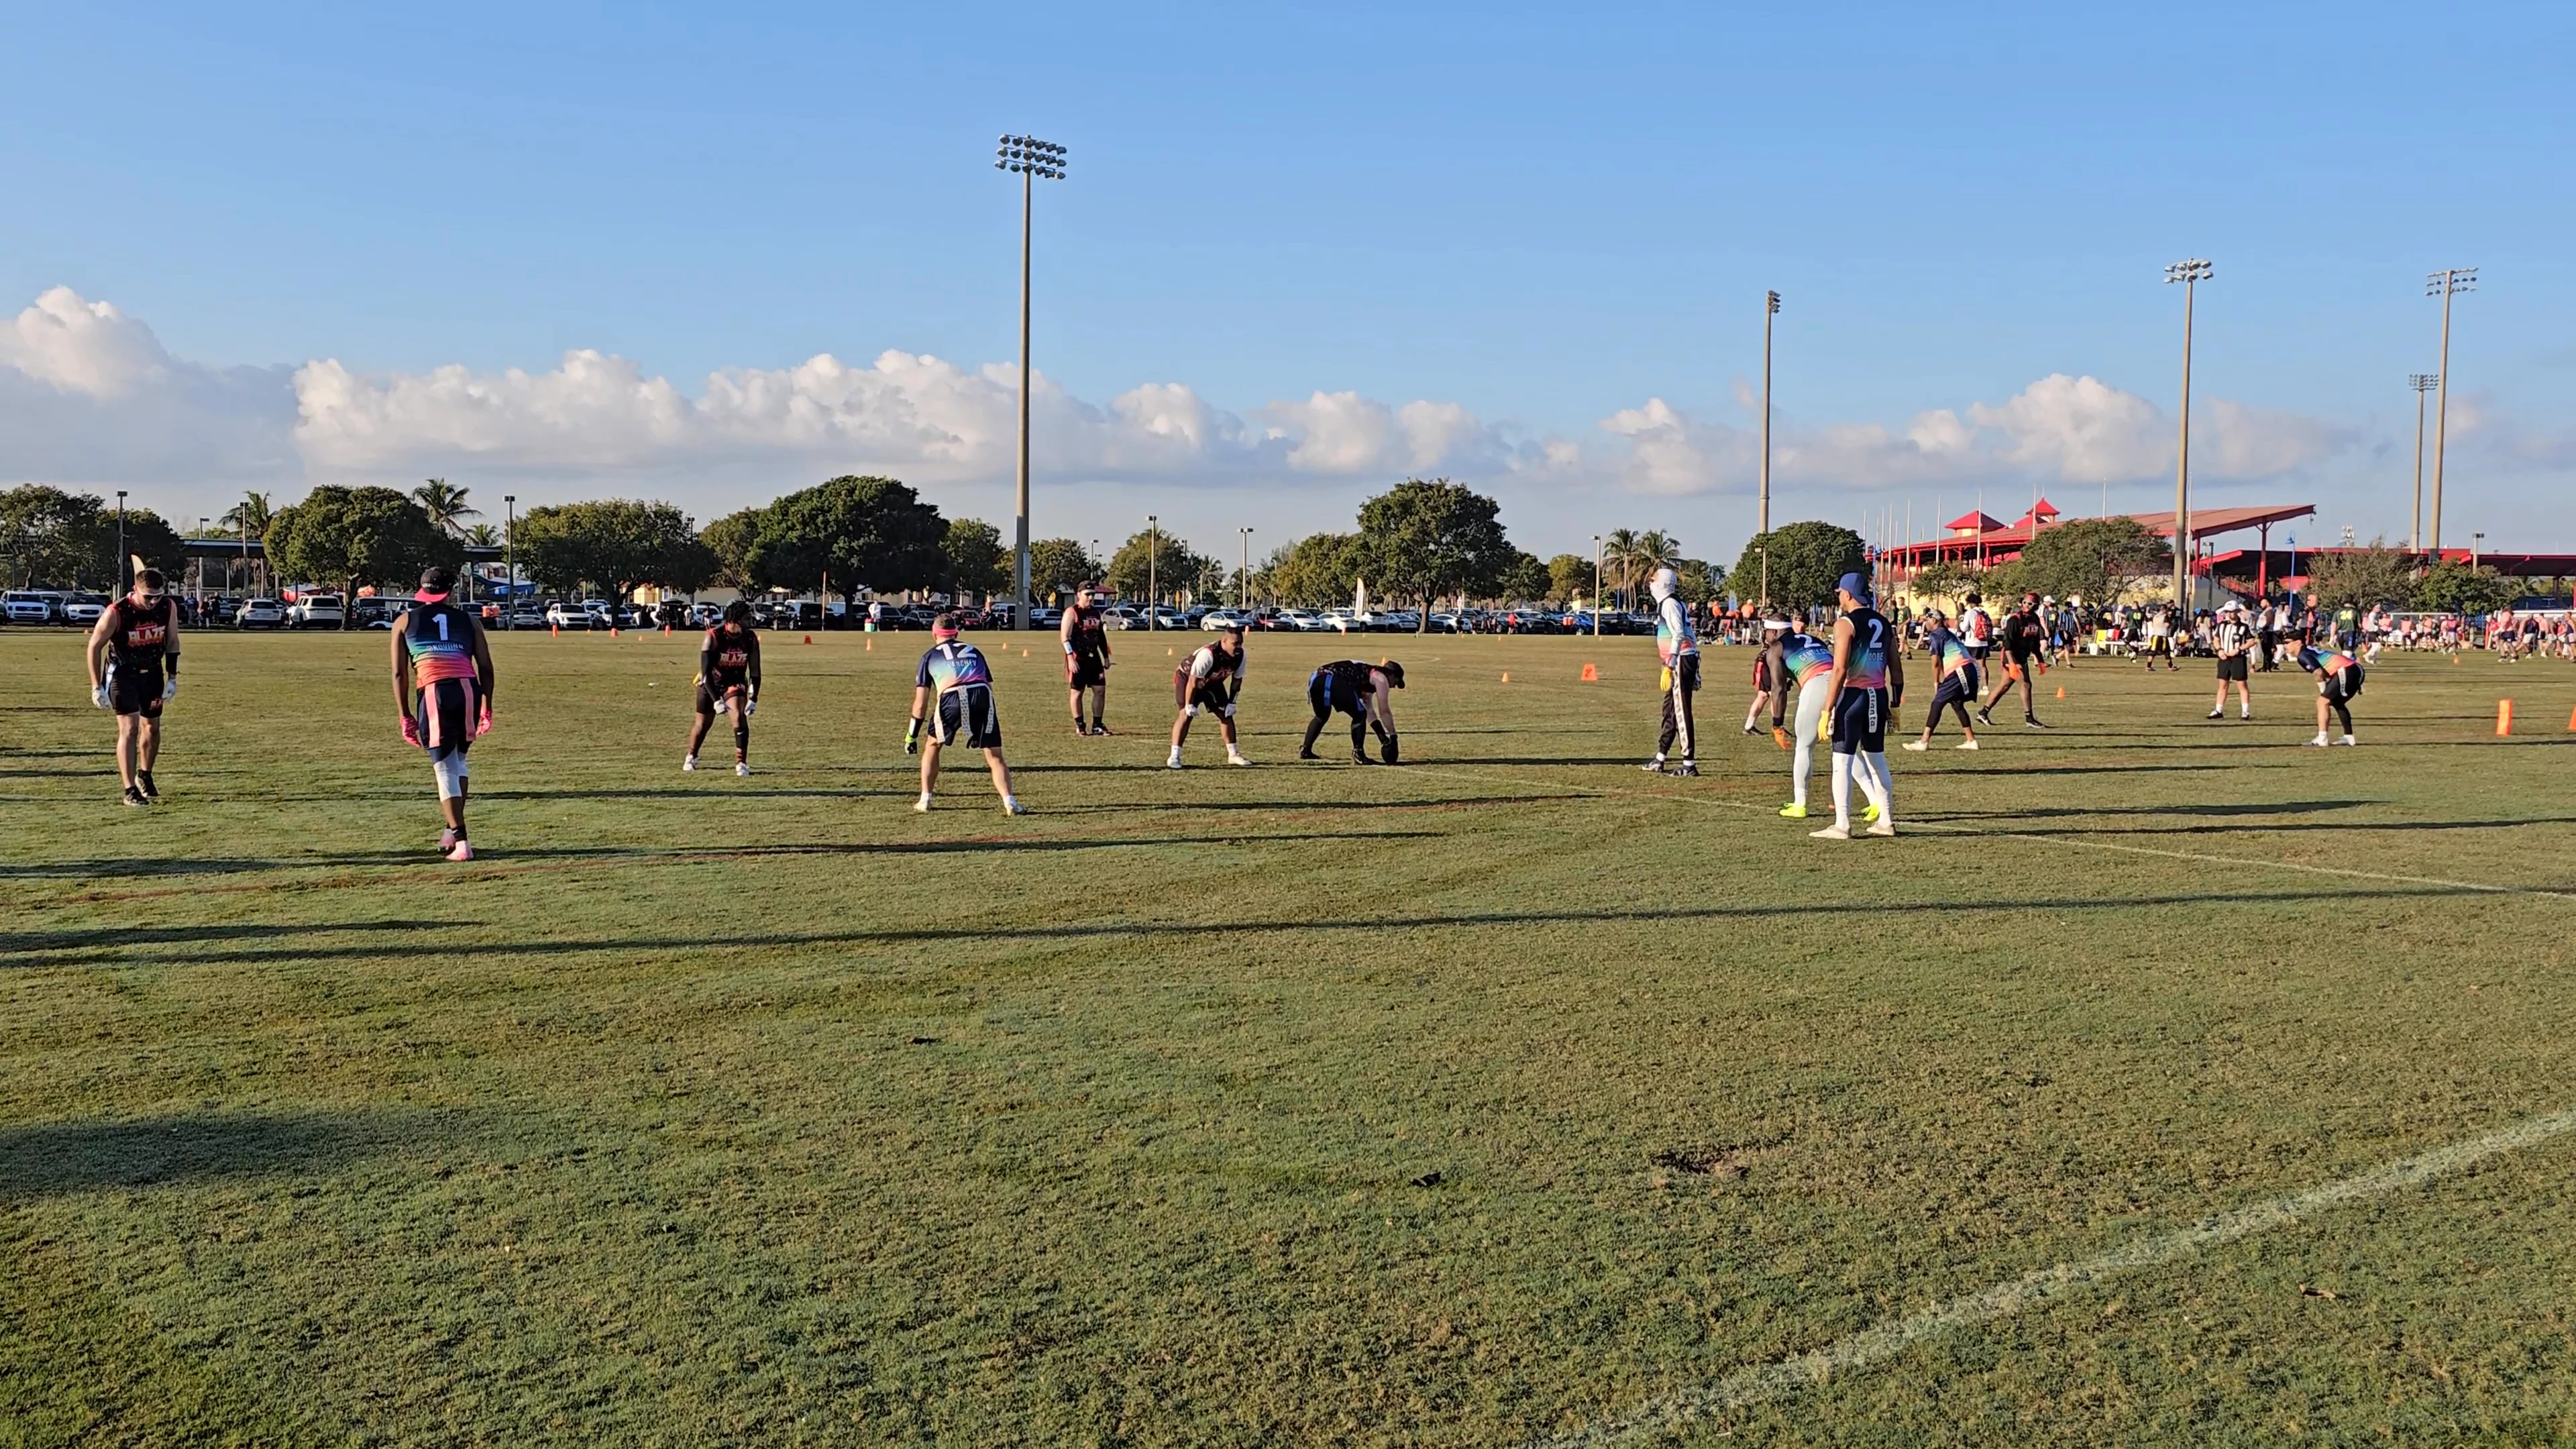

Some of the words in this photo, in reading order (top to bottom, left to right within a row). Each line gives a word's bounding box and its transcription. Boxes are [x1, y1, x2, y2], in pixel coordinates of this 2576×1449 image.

[431, 613, 448, 641] 1
[1868, 619, 1883, 649] 2
[936, 643, 977, 660] 12
[1794, 634, 1821, 649] 2
